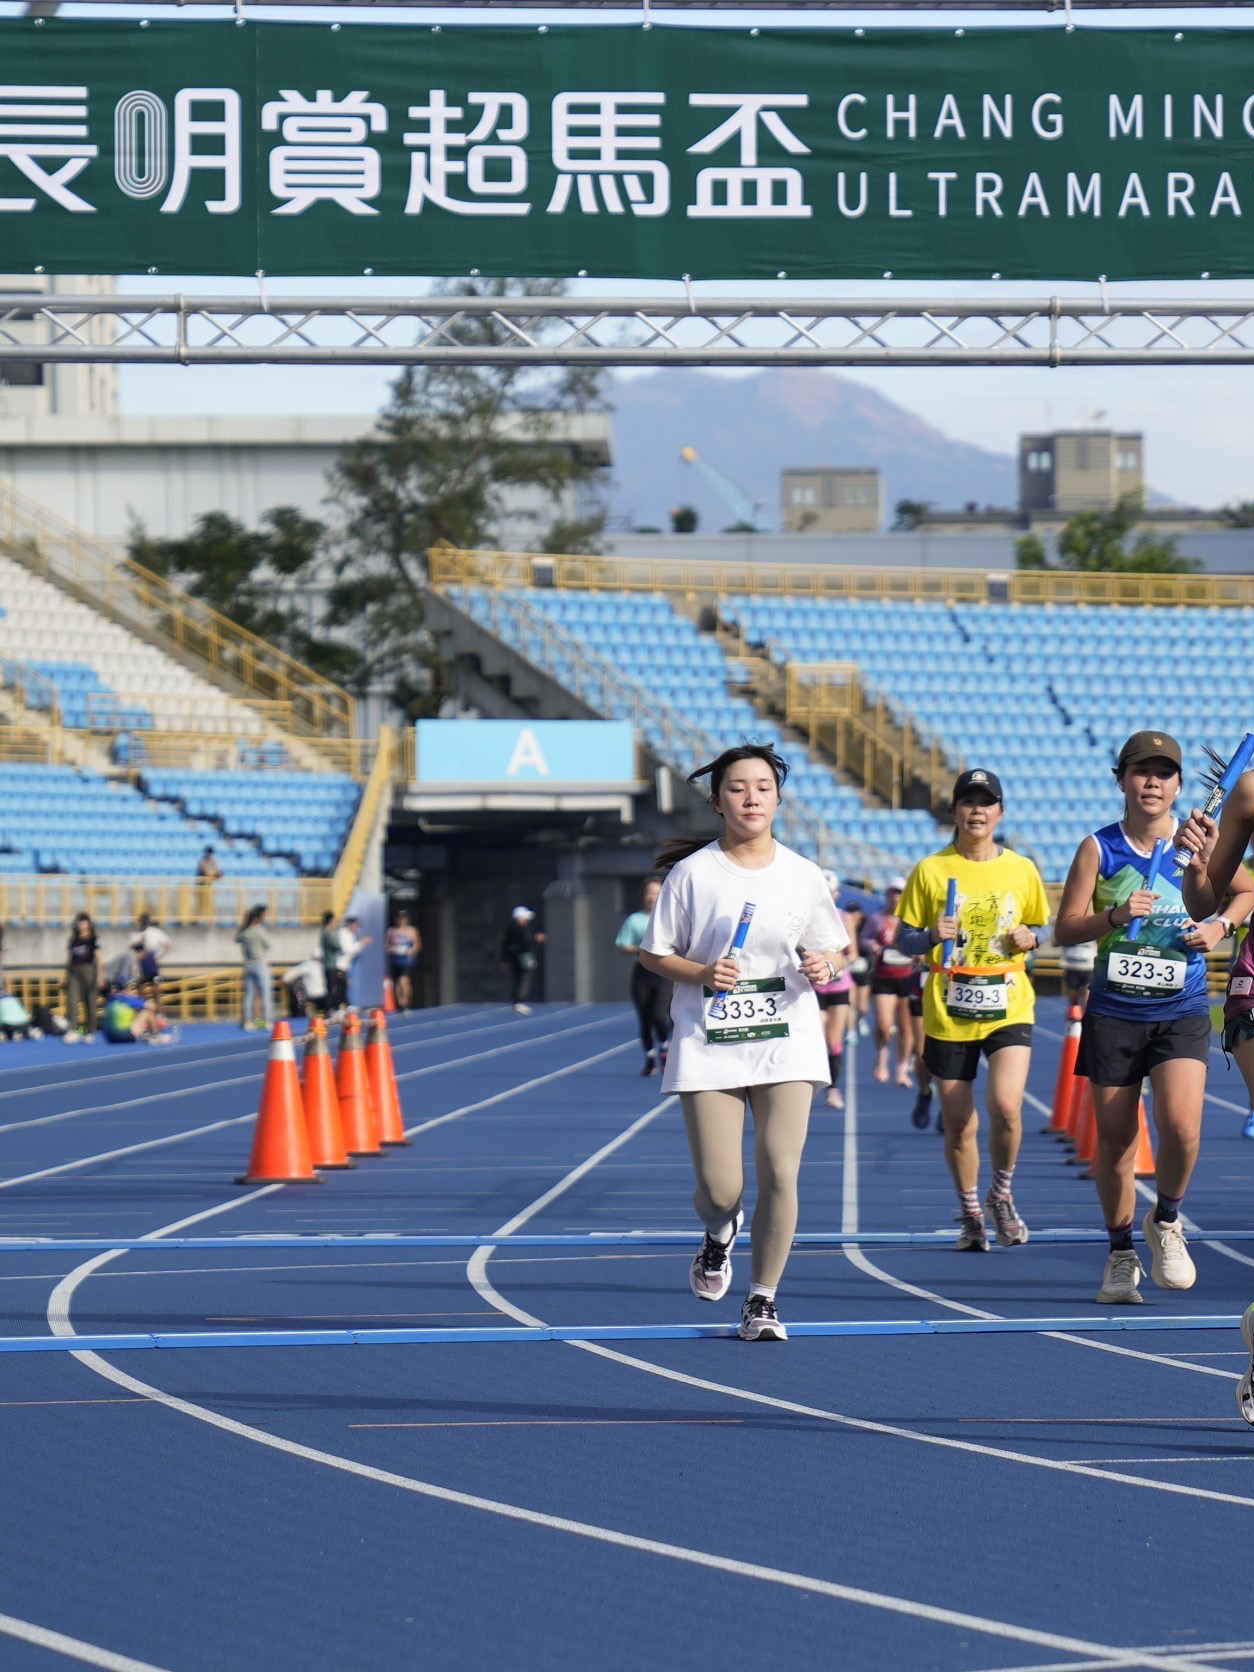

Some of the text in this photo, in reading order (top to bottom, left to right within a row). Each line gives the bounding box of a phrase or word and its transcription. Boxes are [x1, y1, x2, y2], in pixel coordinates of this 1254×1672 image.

[837, 92, 1063, 139] CHANG
[505, 727, 549, 777] A
[1118, 959, 1175, 982] 323-3
[955, 986, 1000, 1004] 329-3
